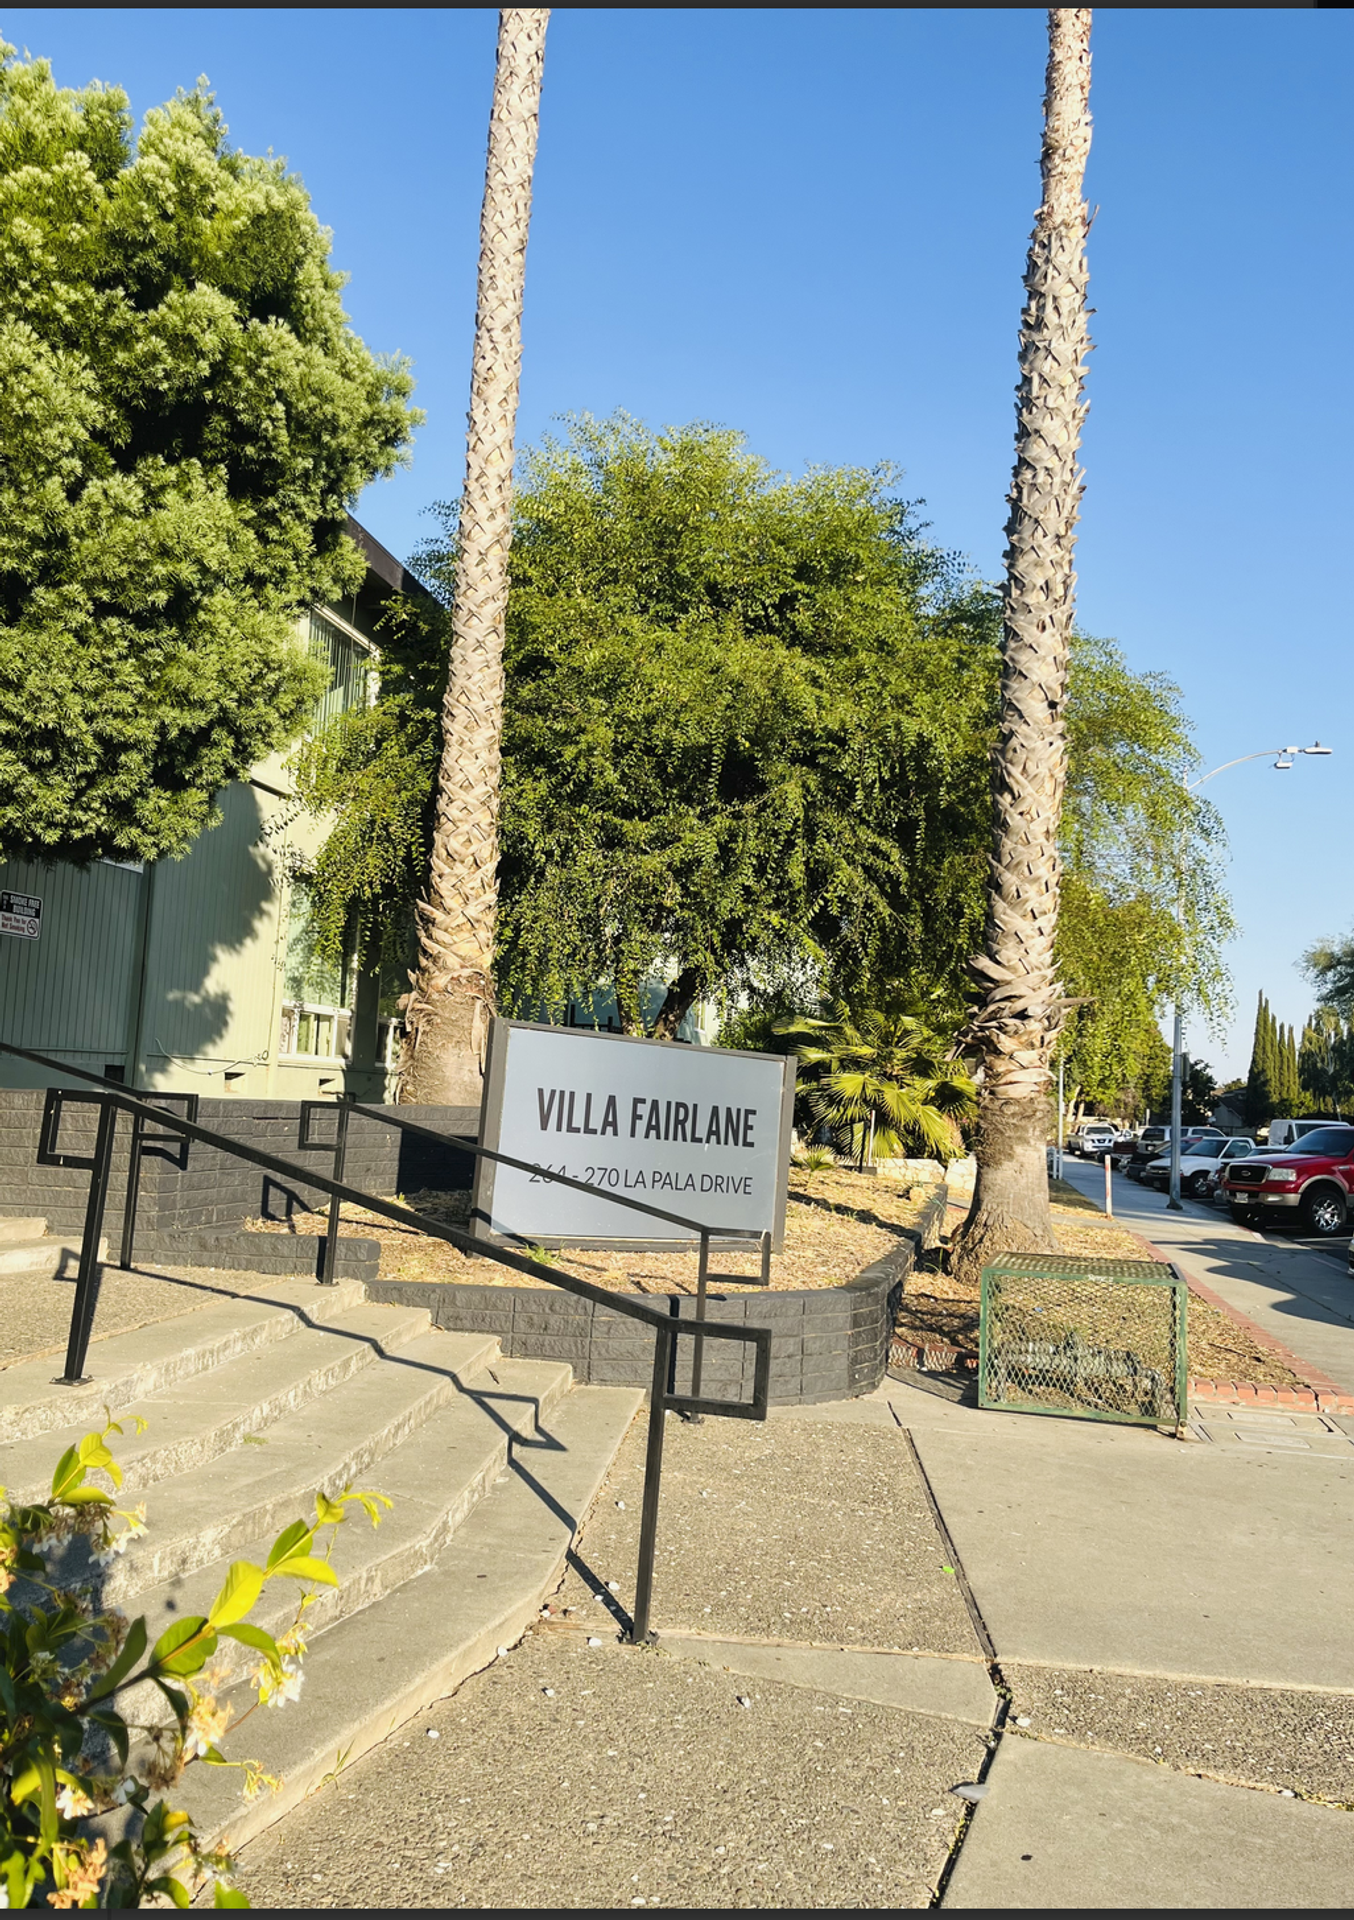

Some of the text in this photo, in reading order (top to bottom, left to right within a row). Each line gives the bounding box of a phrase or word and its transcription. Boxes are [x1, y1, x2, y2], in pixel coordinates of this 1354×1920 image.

[537, 1087, 758, 1148] VILLA FAIRLANE
[584, 1166, 620, 1188] 270
[624, 1168, 647, 1189] LA
[651, 1170, 697, 1193] PALA
[700, 1173, 753, 1195] DRIVE
